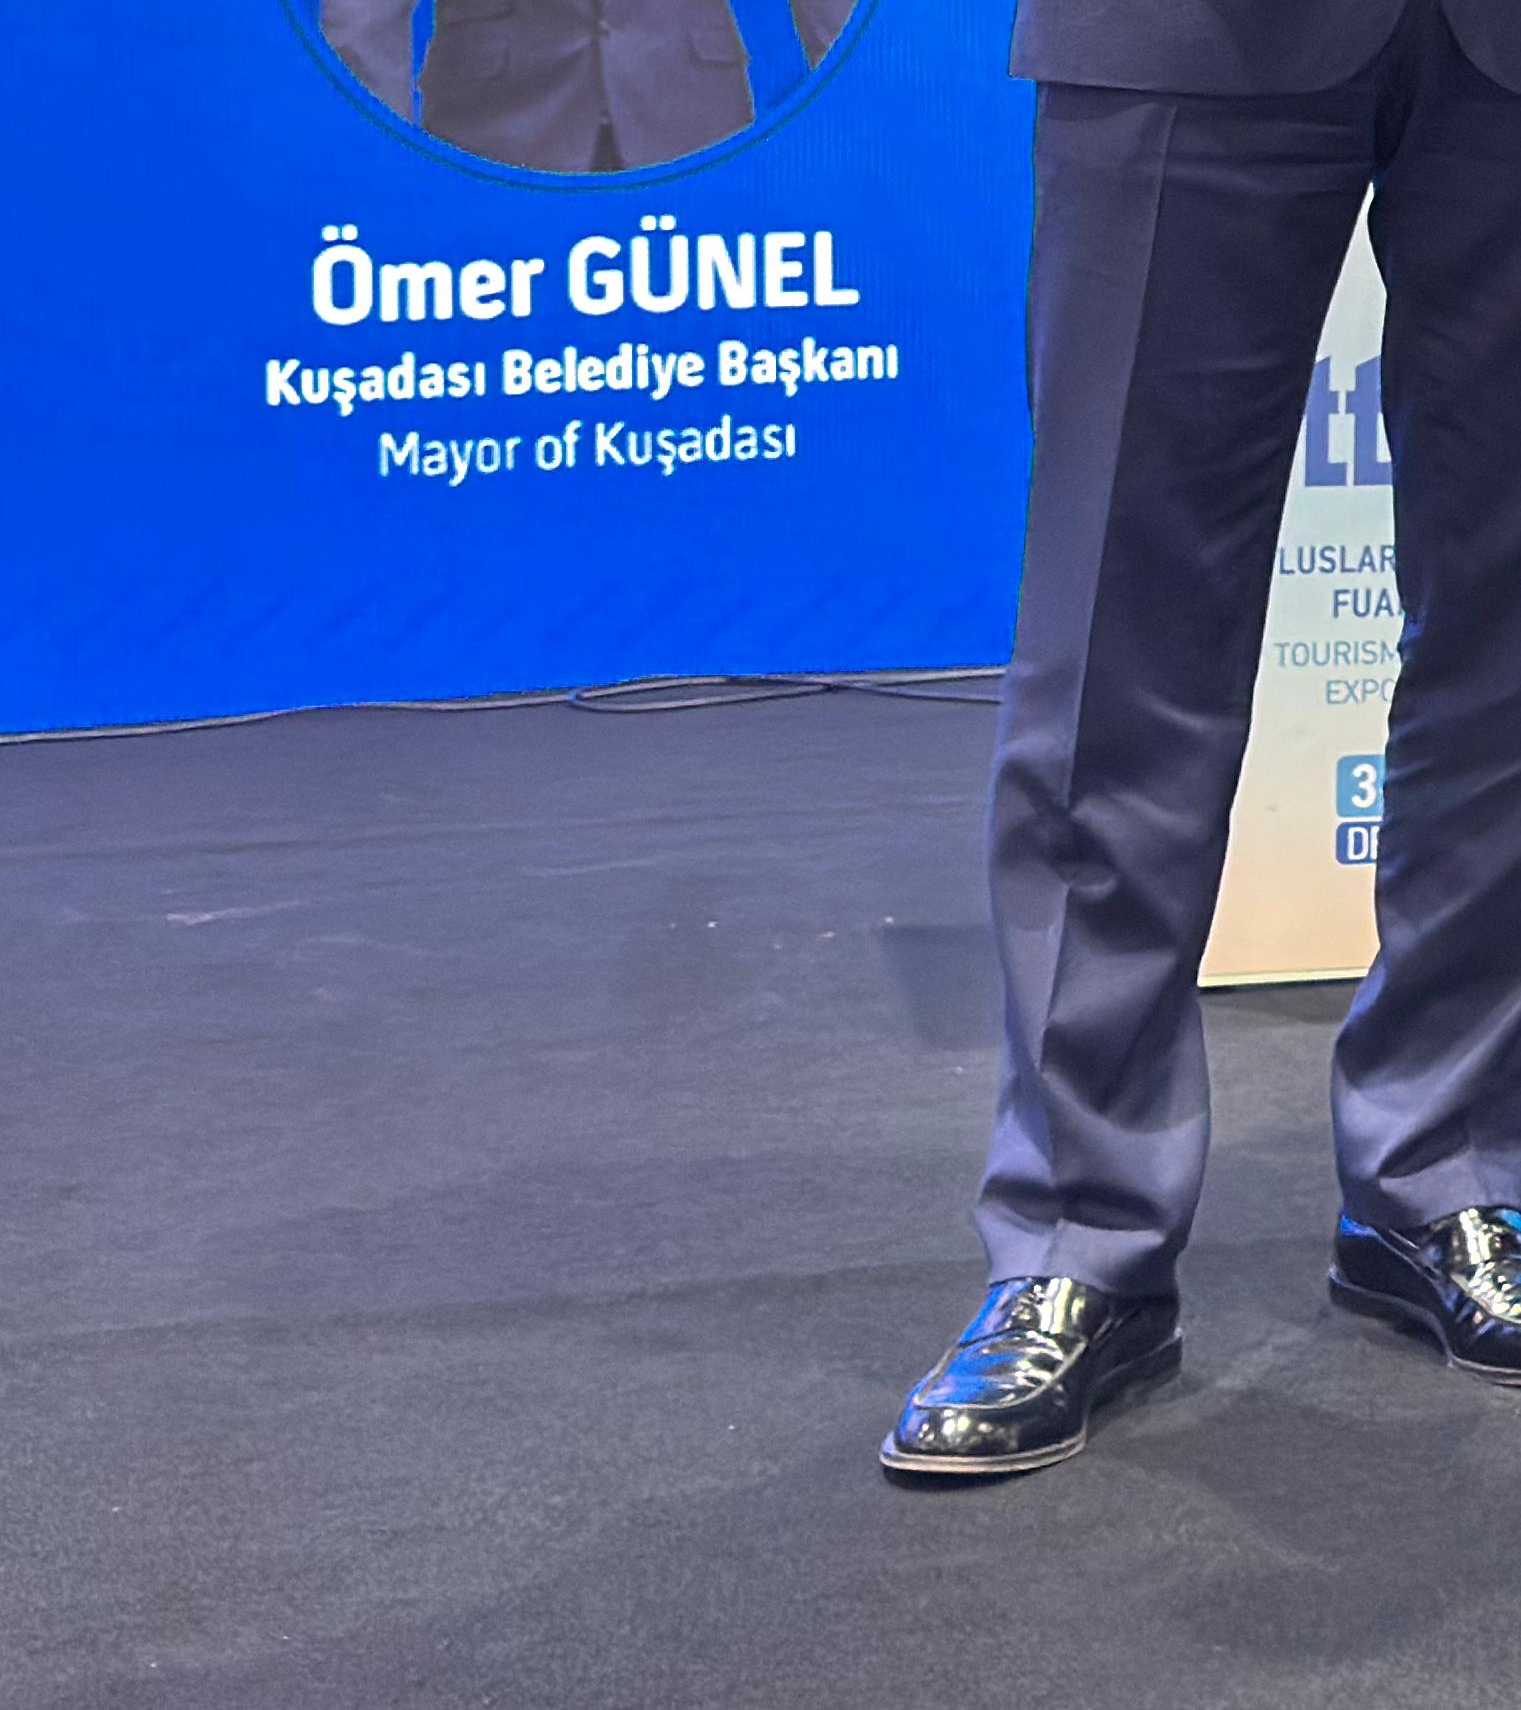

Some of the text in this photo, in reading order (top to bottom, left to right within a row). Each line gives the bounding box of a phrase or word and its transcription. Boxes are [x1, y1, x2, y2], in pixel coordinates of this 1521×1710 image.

[313, 215, 859, 326] Ömer GÜNEL
[266, 337, 898, 417] Kuşadası Belediye Başkanı
[380, 414, 796, 487] Mayor of Kuşadası
[1279, 544, 1396, 575] LUSLAR
[1332, 588, 1404, 619] FUA
